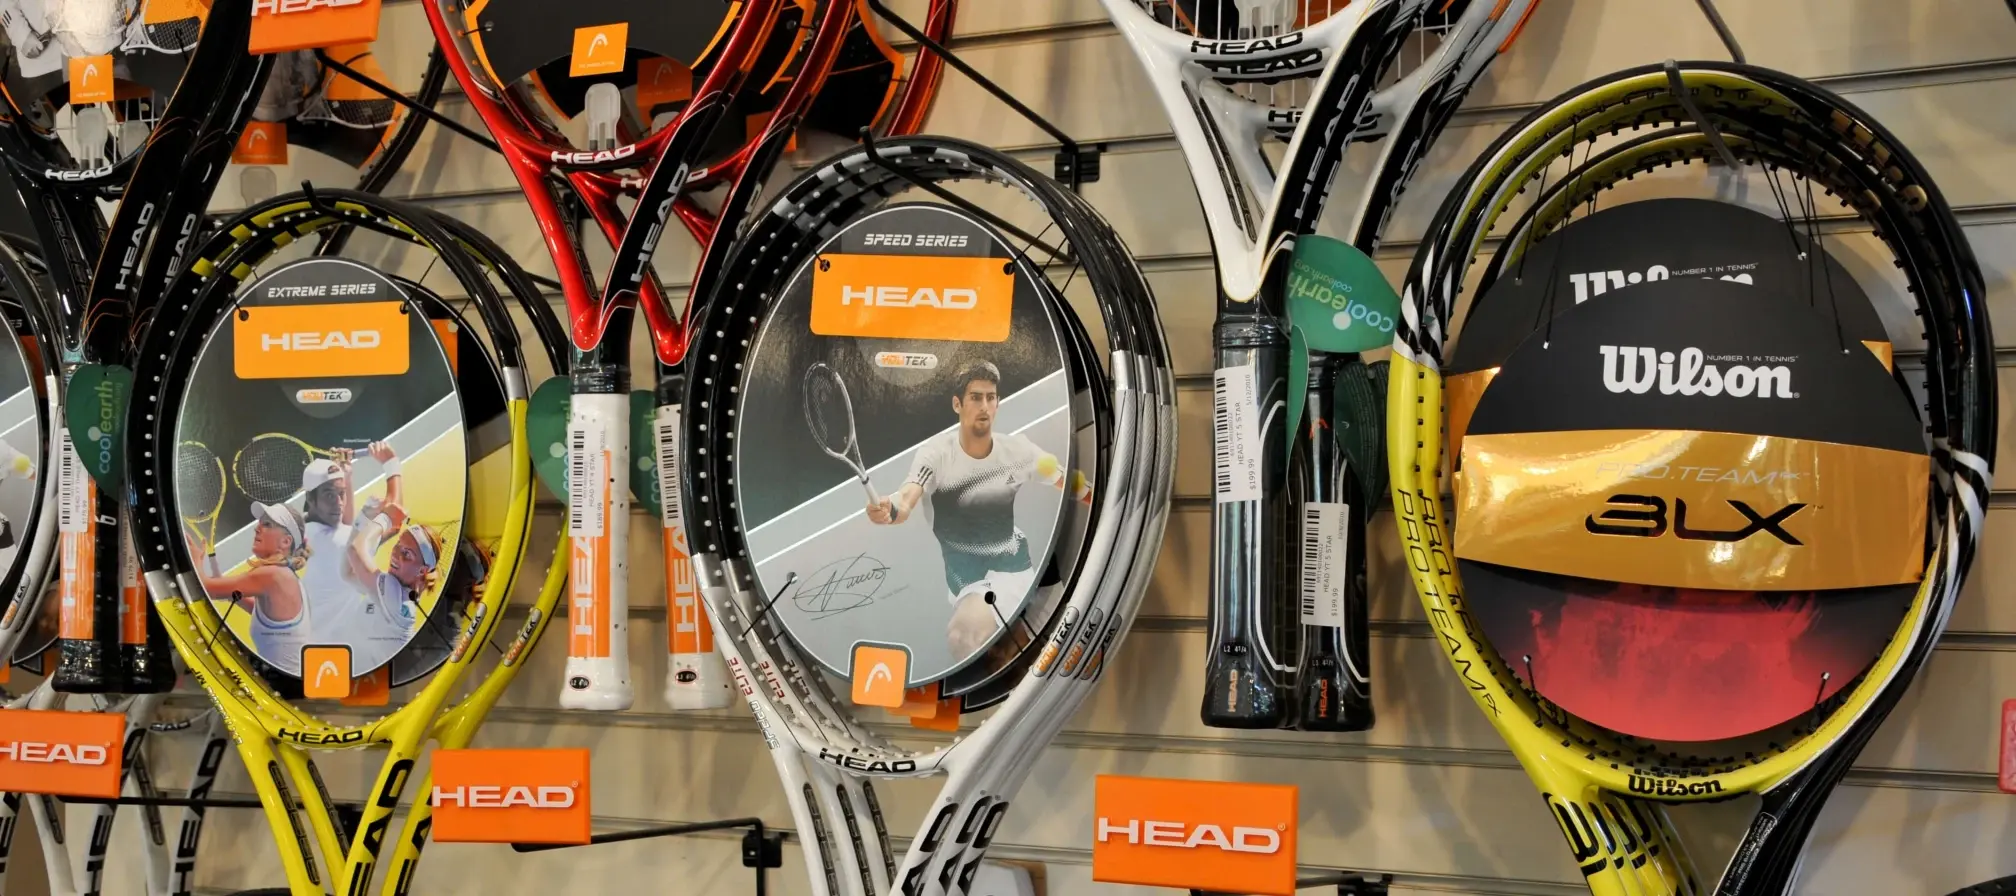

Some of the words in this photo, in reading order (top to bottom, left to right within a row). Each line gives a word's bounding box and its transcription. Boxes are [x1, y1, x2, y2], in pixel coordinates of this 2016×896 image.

[1191, 32, 1303, 54] HEAD
[551, 144, 635, 164] HEAD
[45, 165, 113, 182] HEAD
[630, 161, 689, 282] HEAD
[115, 201, 154, 290] HEAD
[864, 233, 911, 246] SPEED
[915, 235, 968, 247] SERIES
[1672, 267, 1707, 276] NUMBER
[1727, 263, 1756, 271] TENNIS
[268, 286, 326, 298] EXTREME
[330, 283, 376, 296] SERIES
[841, 286, 978, 310] HEAD
[261, 330, 380, 352] HEAD
[1765, 355, 1796, 363] TENNIS
[1600, 345, 1794, 399] Wilson
[1236, 432, 1243, 441] YT
[1236, 443, 1244, 465] HEAD
[1248, 458, 1257, 490] $199.99
[1585, 493, 1808, 546] BLX
[575, 536, 593, 635] HEA
[672, 527, 695, 632] HEA
[1228, 669, 1238, 713] HEAD
[1318, 679, 1328, 717] HEAD
[278, 728, 362, 745] HEAD
[0, 742, 107, 765] HEAD
[819, 748, 916, 773] HEAD
[432, 785, 575, 808] HEAD
[1628, 774, 1724, 796] Wilson
[1098, 817, 1281, 854] HEAD
